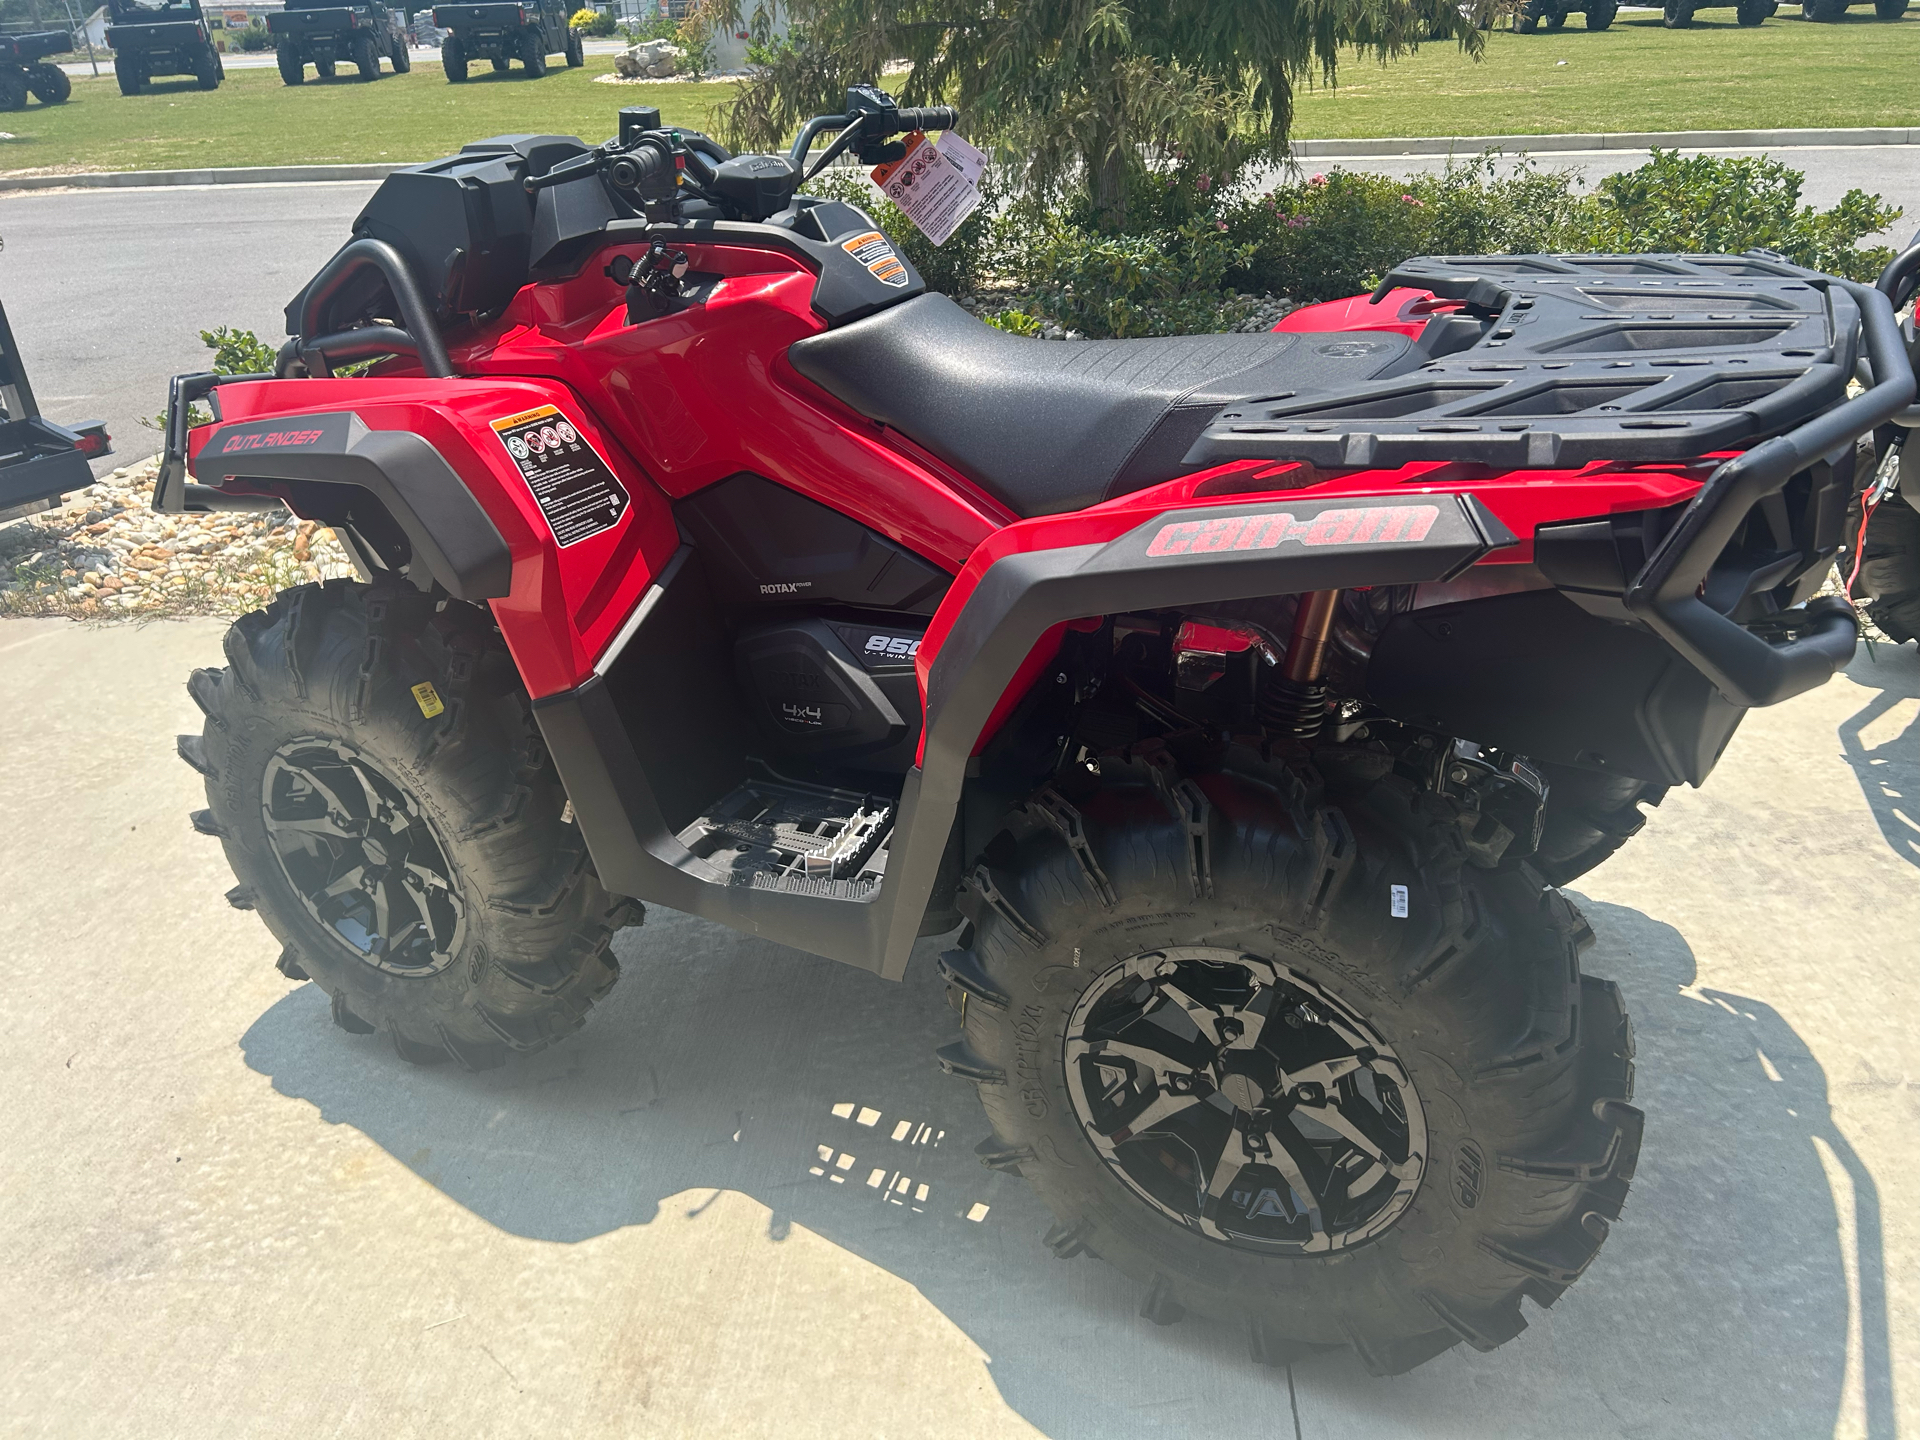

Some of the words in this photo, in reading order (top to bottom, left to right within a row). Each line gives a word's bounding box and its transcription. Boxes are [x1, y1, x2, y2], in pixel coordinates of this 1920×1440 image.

[518, 412, 541, 423] WARNING
[222, 430, 324, 453] OUTLANDER
[1147, 505, 1439, 557] can-am
[759, 583, 798, 594] ROTAX
[782, 702, 822, 719] 4x4
[1455, 1142, 1483, 1209] ITP
